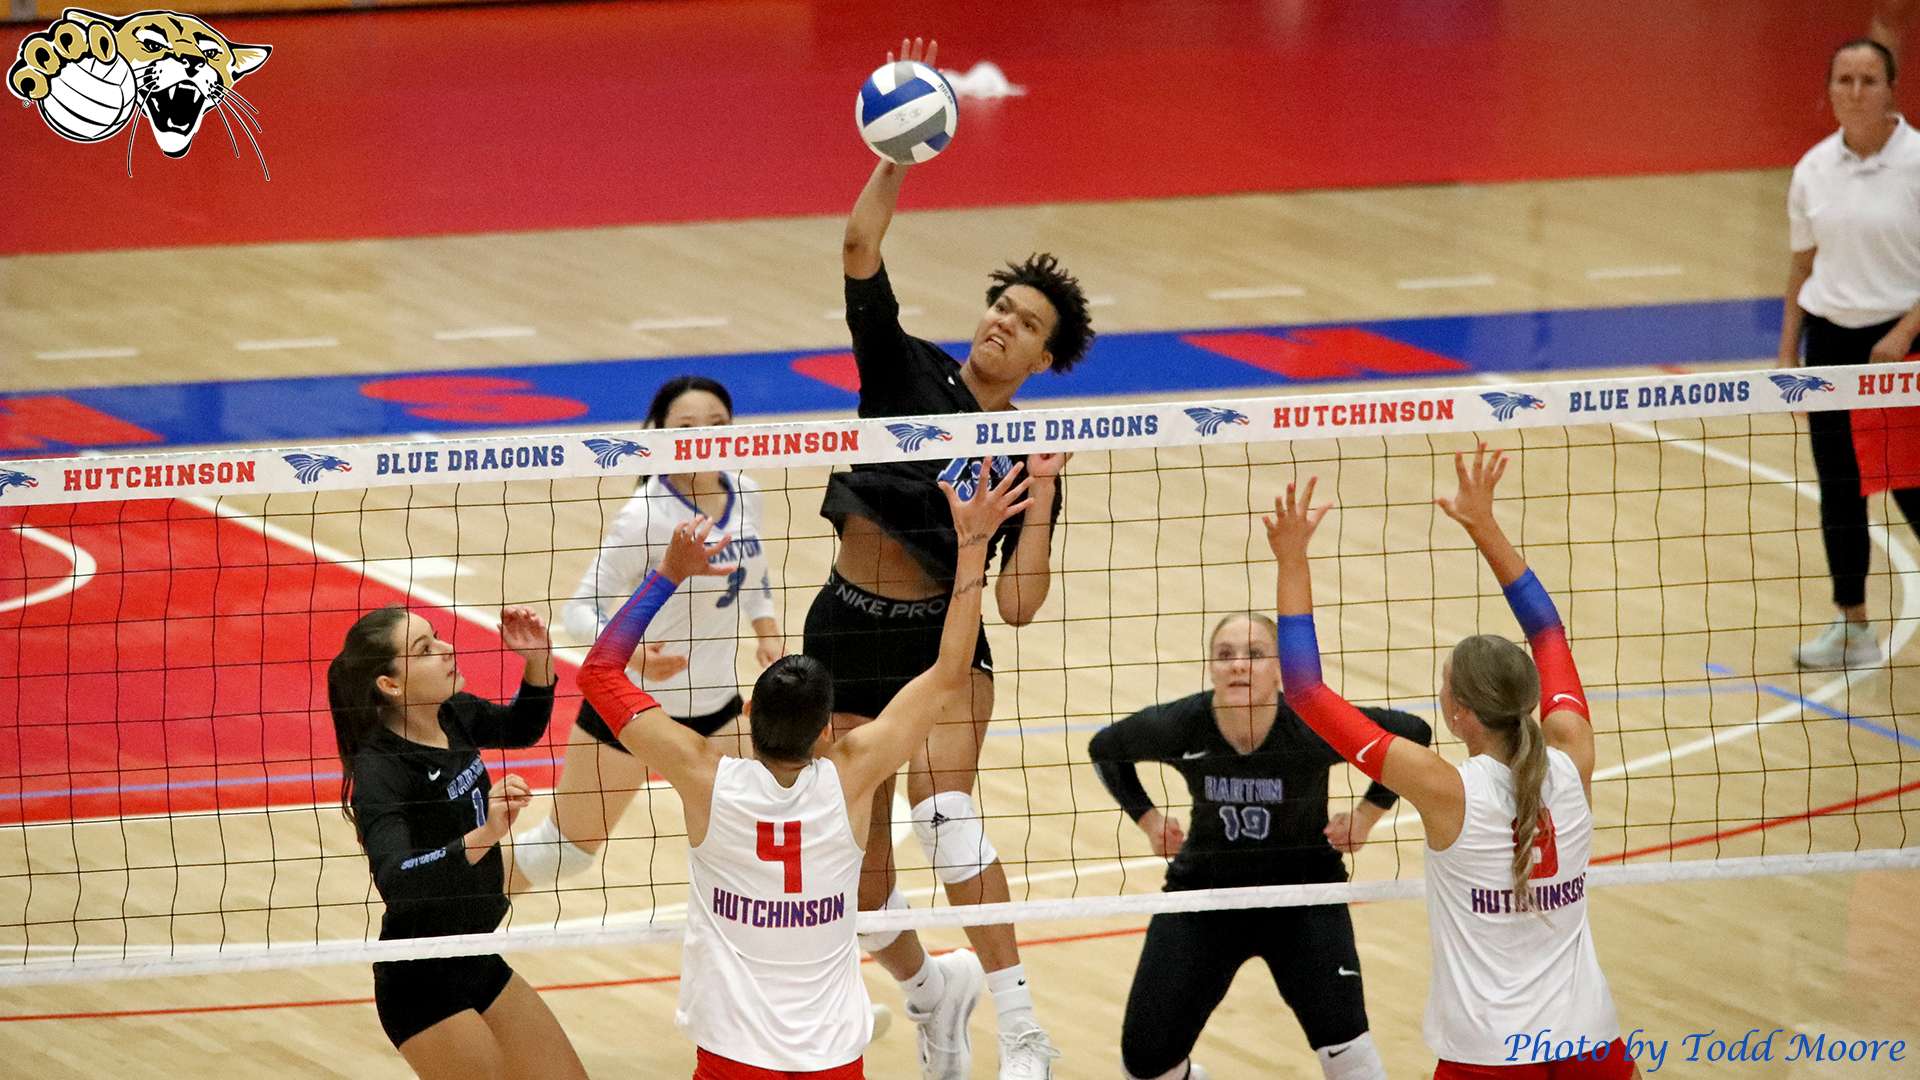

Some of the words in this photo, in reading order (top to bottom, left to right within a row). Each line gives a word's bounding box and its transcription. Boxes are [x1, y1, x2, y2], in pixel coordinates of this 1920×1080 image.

[1570, 389, 1628, 411] BLUE
[1638, 381, 1750, 407] DRAGONS
[1858, 372, 1920, 396] HUT
[1273, 398, 1455, 429] HUTCHINSON
[674, 429, 860, 460] HUTCHINSON
[976, 421, 1035, 444] BLUE
[1046, 415, 1158, 440] DRAGONS
[63, 461, 256, 490] HUTCHINSON
[377, 451, 438, 475] BLUE
[448, 445, 564, 470] DRAGONS
[834, 583, 888, 617] NIKE
[889, 598, 946, 619] PRO
[1219, 805, 1271, 841] 19
[756, 820, 802, 893] 4
[713, 887, 845, 928] HUTCHINSON
